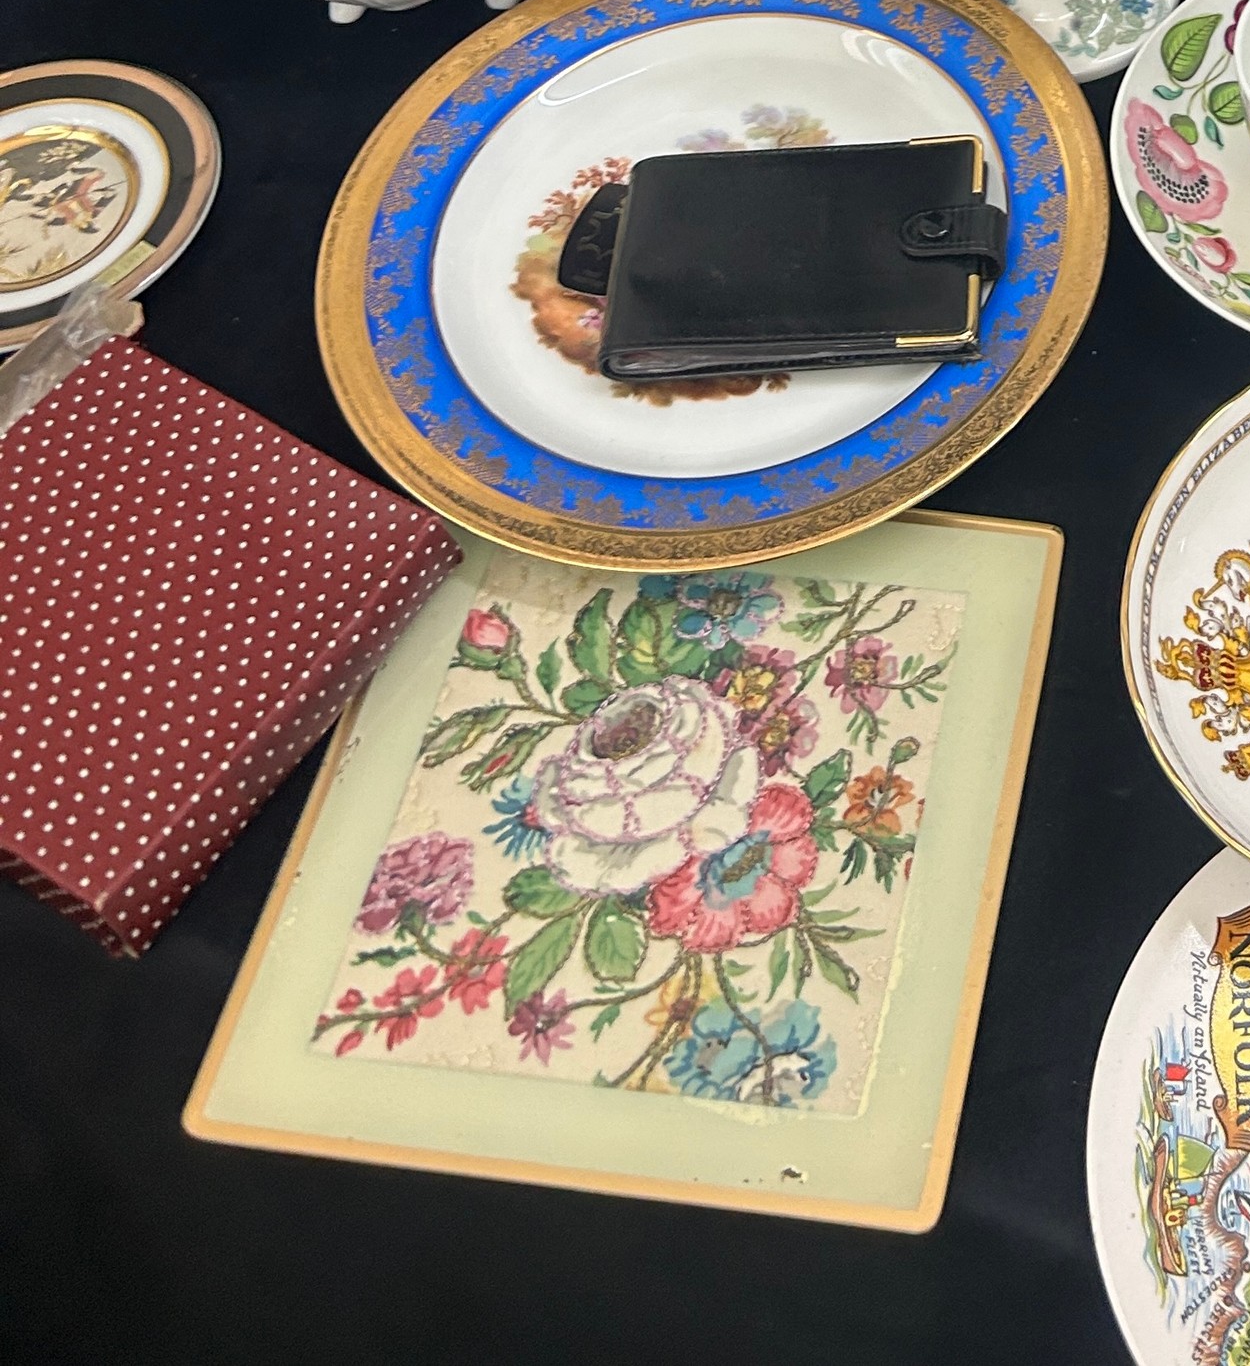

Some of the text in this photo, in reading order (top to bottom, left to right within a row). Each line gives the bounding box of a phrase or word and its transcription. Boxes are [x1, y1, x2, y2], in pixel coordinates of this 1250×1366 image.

[1155, 485, 1192, 546] QUEEN
[1183, 949, 1205, 1022] Virtually
[1193, 1026, 1204, 1047] an
[1184, 1234, 1201, 1276] FLEET
[1191, 1303, 1226, 1365] BECCLES
